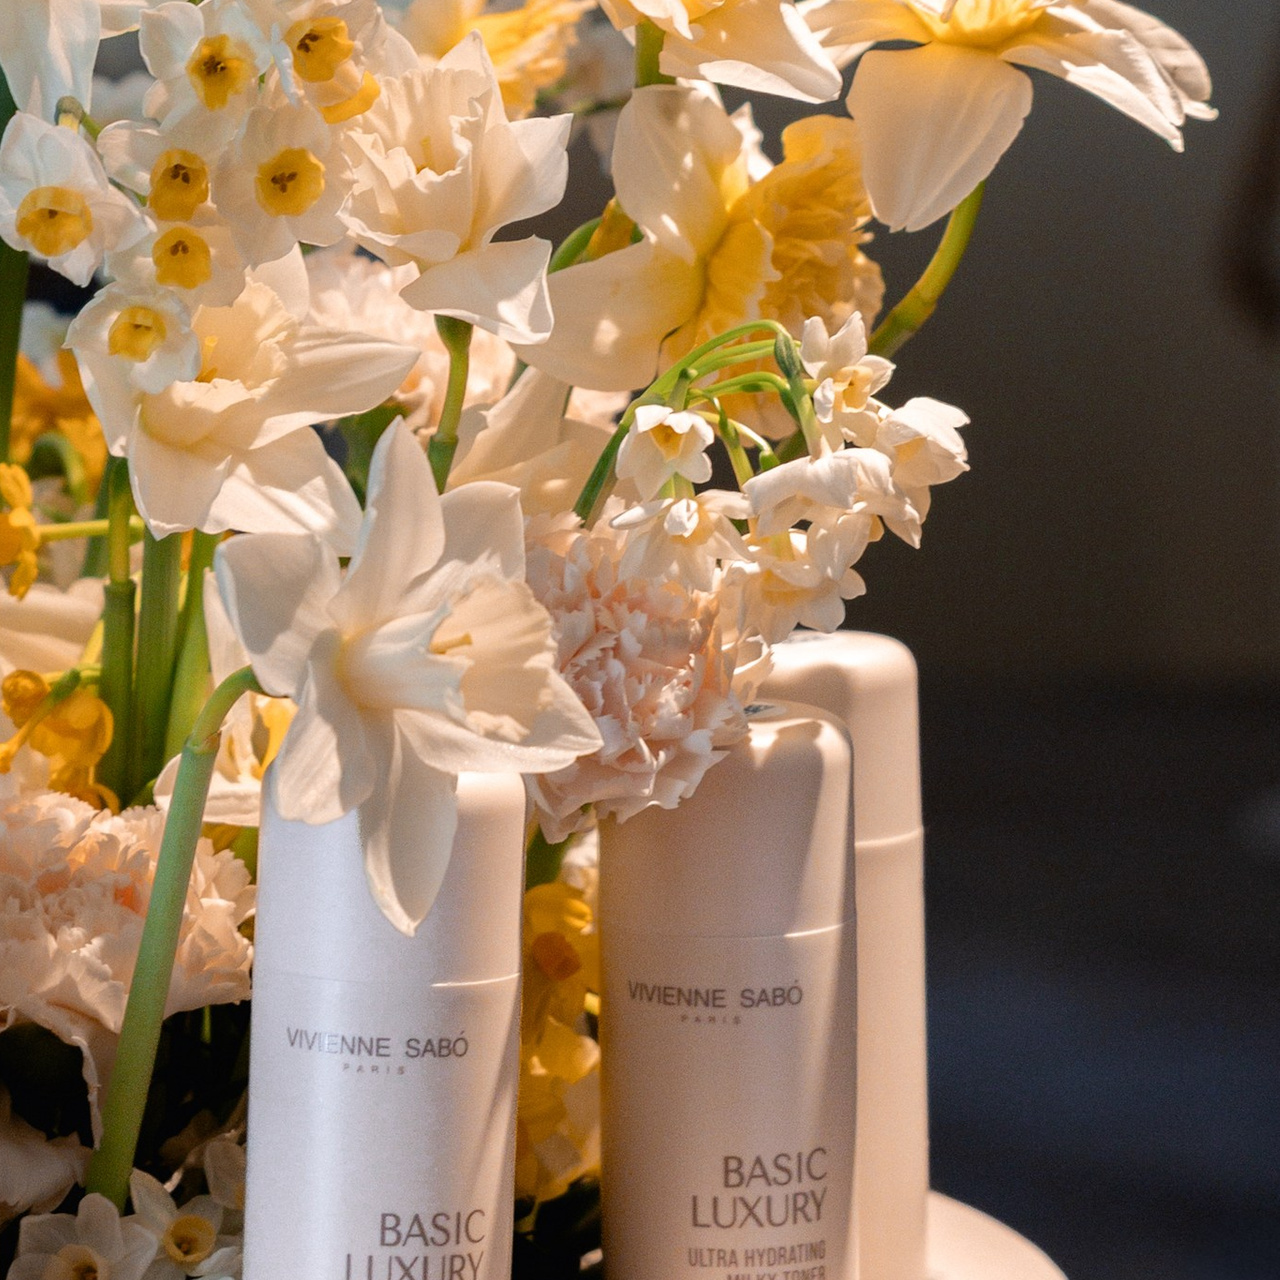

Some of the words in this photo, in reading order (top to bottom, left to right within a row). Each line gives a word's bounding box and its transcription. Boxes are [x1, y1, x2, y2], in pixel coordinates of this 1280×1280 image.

[627, 979, 727, 1009] VIVIENNE
[740, 978, 804, 1009] SABÓ
[286, 1026, 391, 1058] VIVIENNE
[405, 1029, 469, 1059] SABÓ
[723, 1147, 828, 1189] BASIC
[691, 1186, 828, 1229] LUXURY
[380, 1208, 486, 1247] BASIC
[688, 1247, 739, 1269] ULTRA
[744, 1240, 827, 1268] HYDRATING
